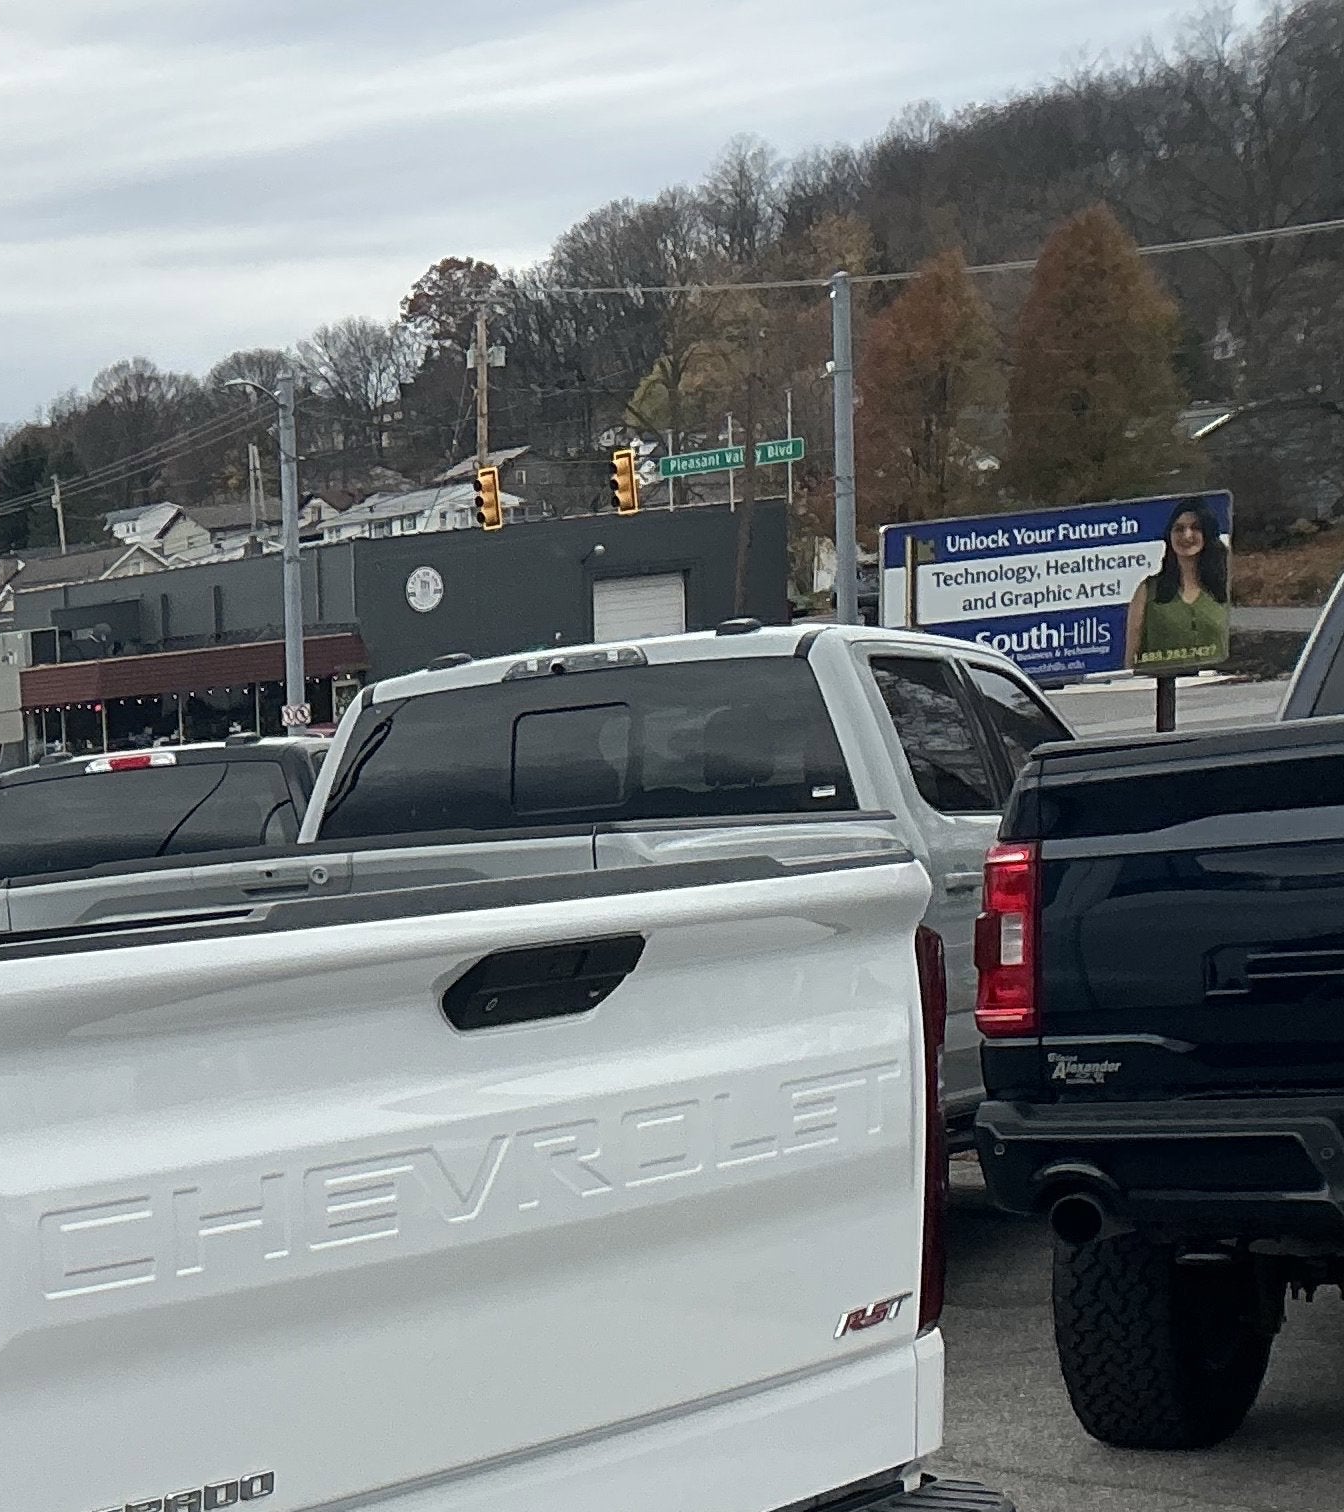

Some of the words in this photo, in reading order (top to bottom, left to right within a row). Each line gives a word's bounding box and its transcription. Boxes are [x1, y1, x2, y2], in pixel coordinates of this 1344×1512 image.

[670, 454, 720, 472] Pleasant
[725, 450, 760, 463] Valy
[767, 442, 793, 458] Blvd
[946, 529, 1010, 553] Unlock
[1012, 526, 1056, 546] Your
[1057, 522, 1118, 541] Future
[1121, 516, 1139, 535] in
[932, 562, 1041, 588] Technology,
[1045, 553, 1152, 577] Healthcare,
[962, 591, 997, 611] and
[1000, 583, 1073, 609] Graphic
[1077, 579, 1121, 600] Arts!
[1051, 1060, 1122, 1079] Alexander
[37, 1058, 902, 1302] CHEVROLET
[833, 1291, 913, 1339] RST
